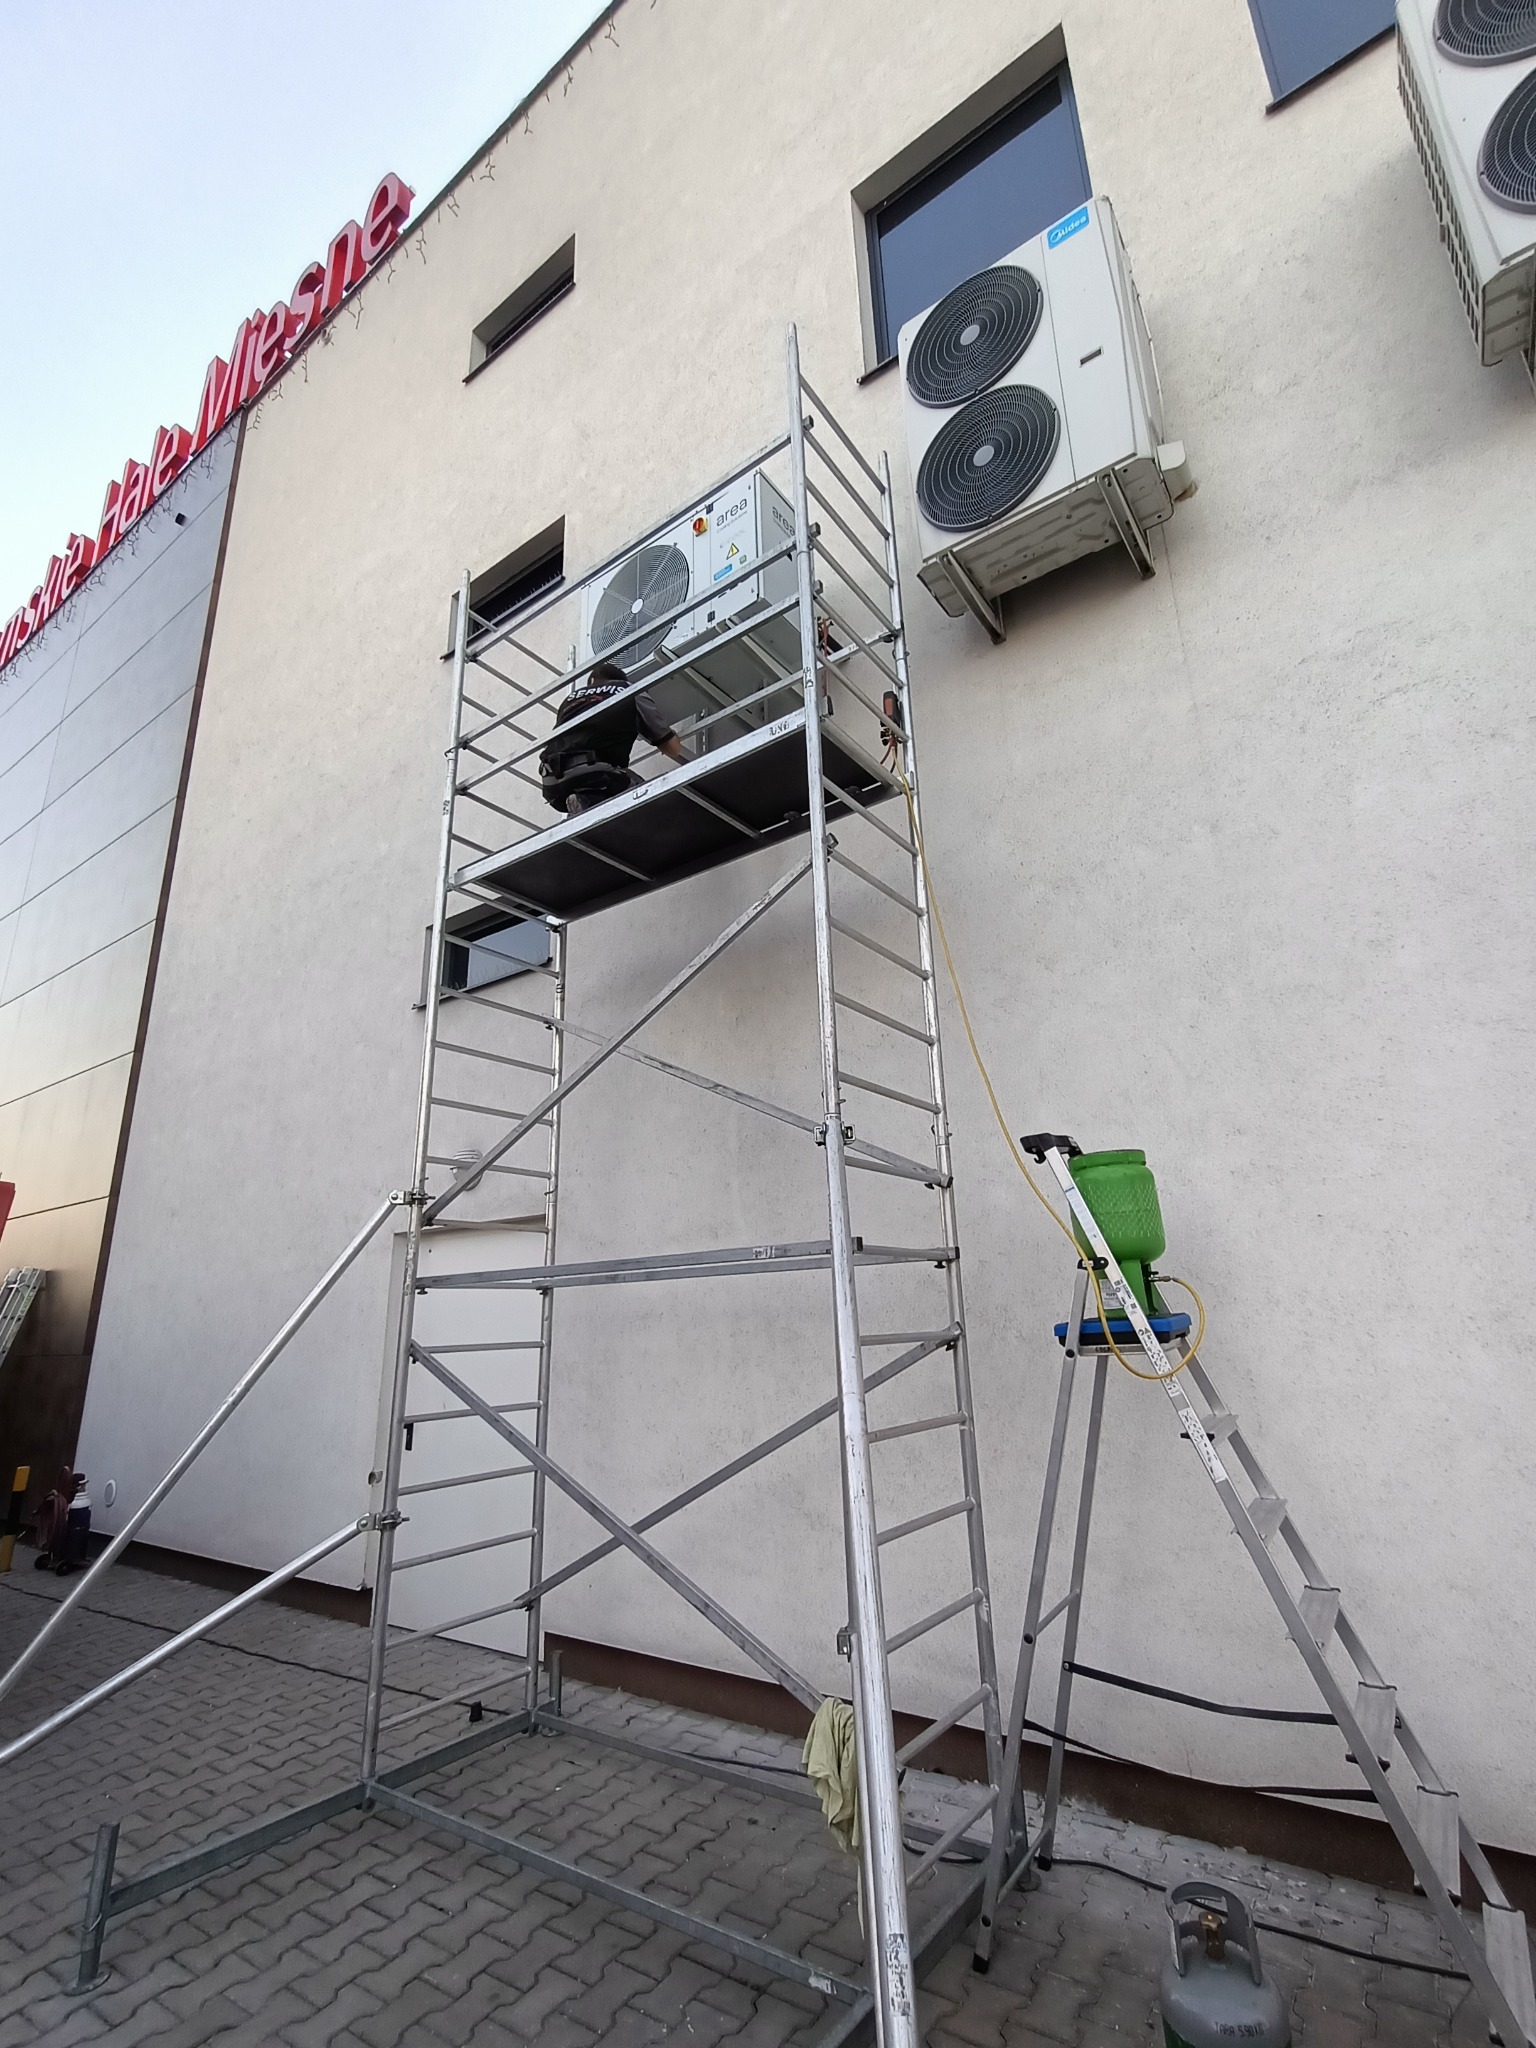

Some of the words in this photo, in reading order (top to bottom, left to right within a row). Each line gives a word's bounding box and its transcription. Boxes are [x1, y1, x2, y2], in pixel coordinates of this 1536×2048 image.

[1050, 216, 1087, 243] Midea
[91, 424, 192, 568] Hale
[190, 172, 413, 454] Mięsne
[717, 498, 748, 527] area
[772, 506, 796, 536] area
[567, 685, 625, 701] SERWIS
